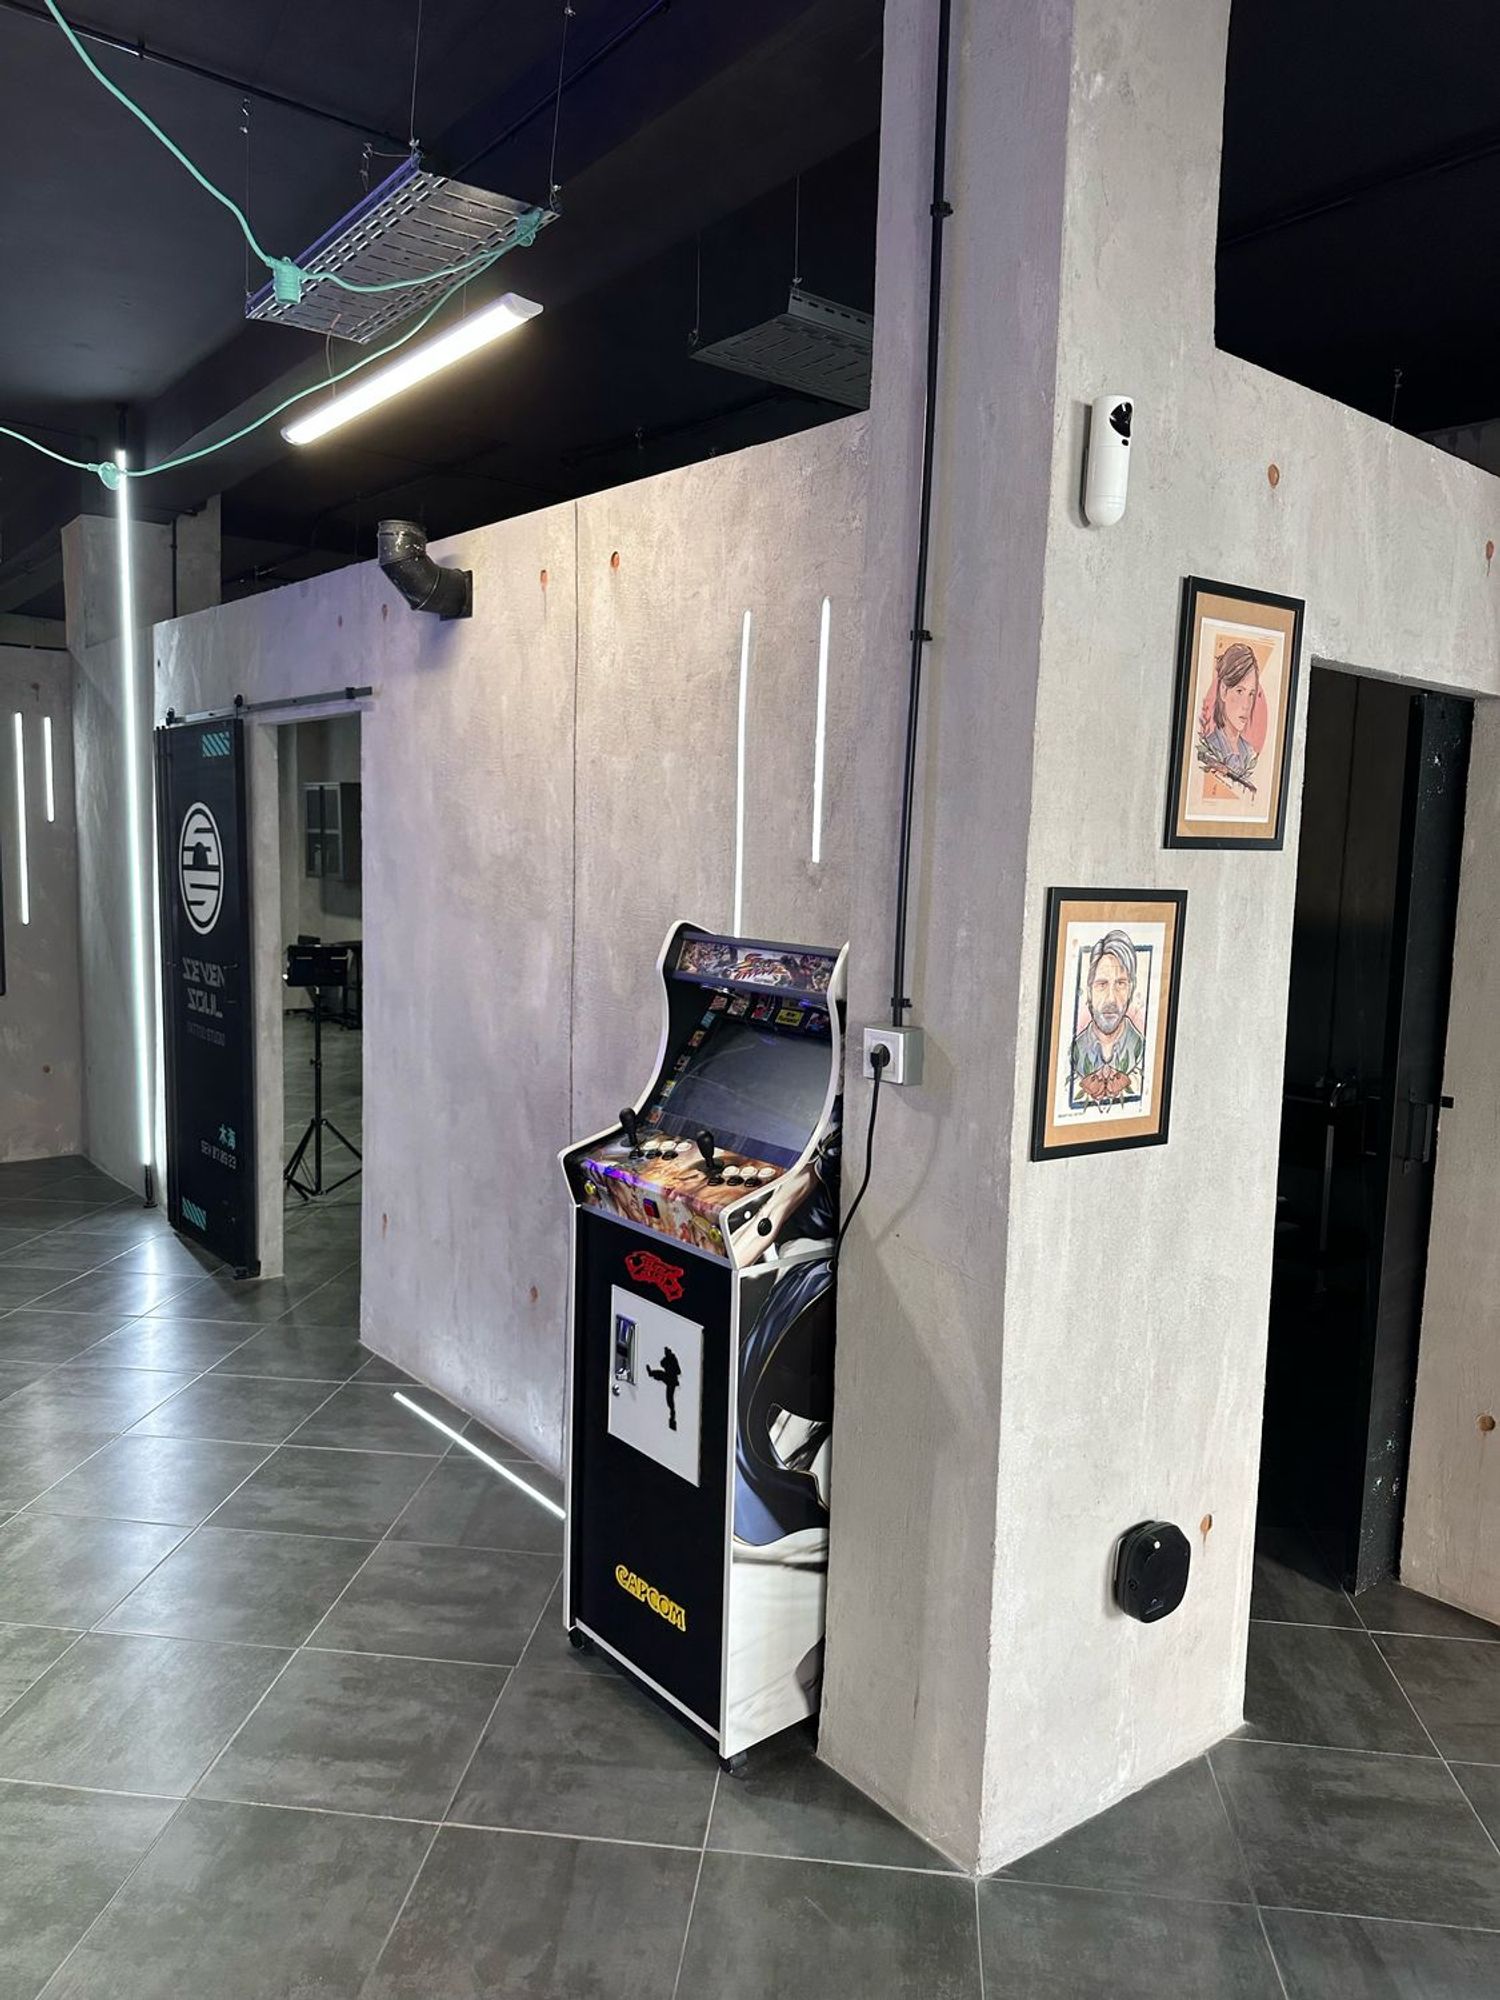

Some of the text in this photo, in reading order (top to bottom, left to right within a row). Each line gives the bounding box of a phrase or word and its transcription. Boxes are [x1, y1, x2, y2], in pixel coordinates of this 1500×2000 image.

[182, 956, 225, 988] SEVEN
[187, 987, 223, 1018] SOUL
[615, 1564, 686, 1632] CAPCOM
